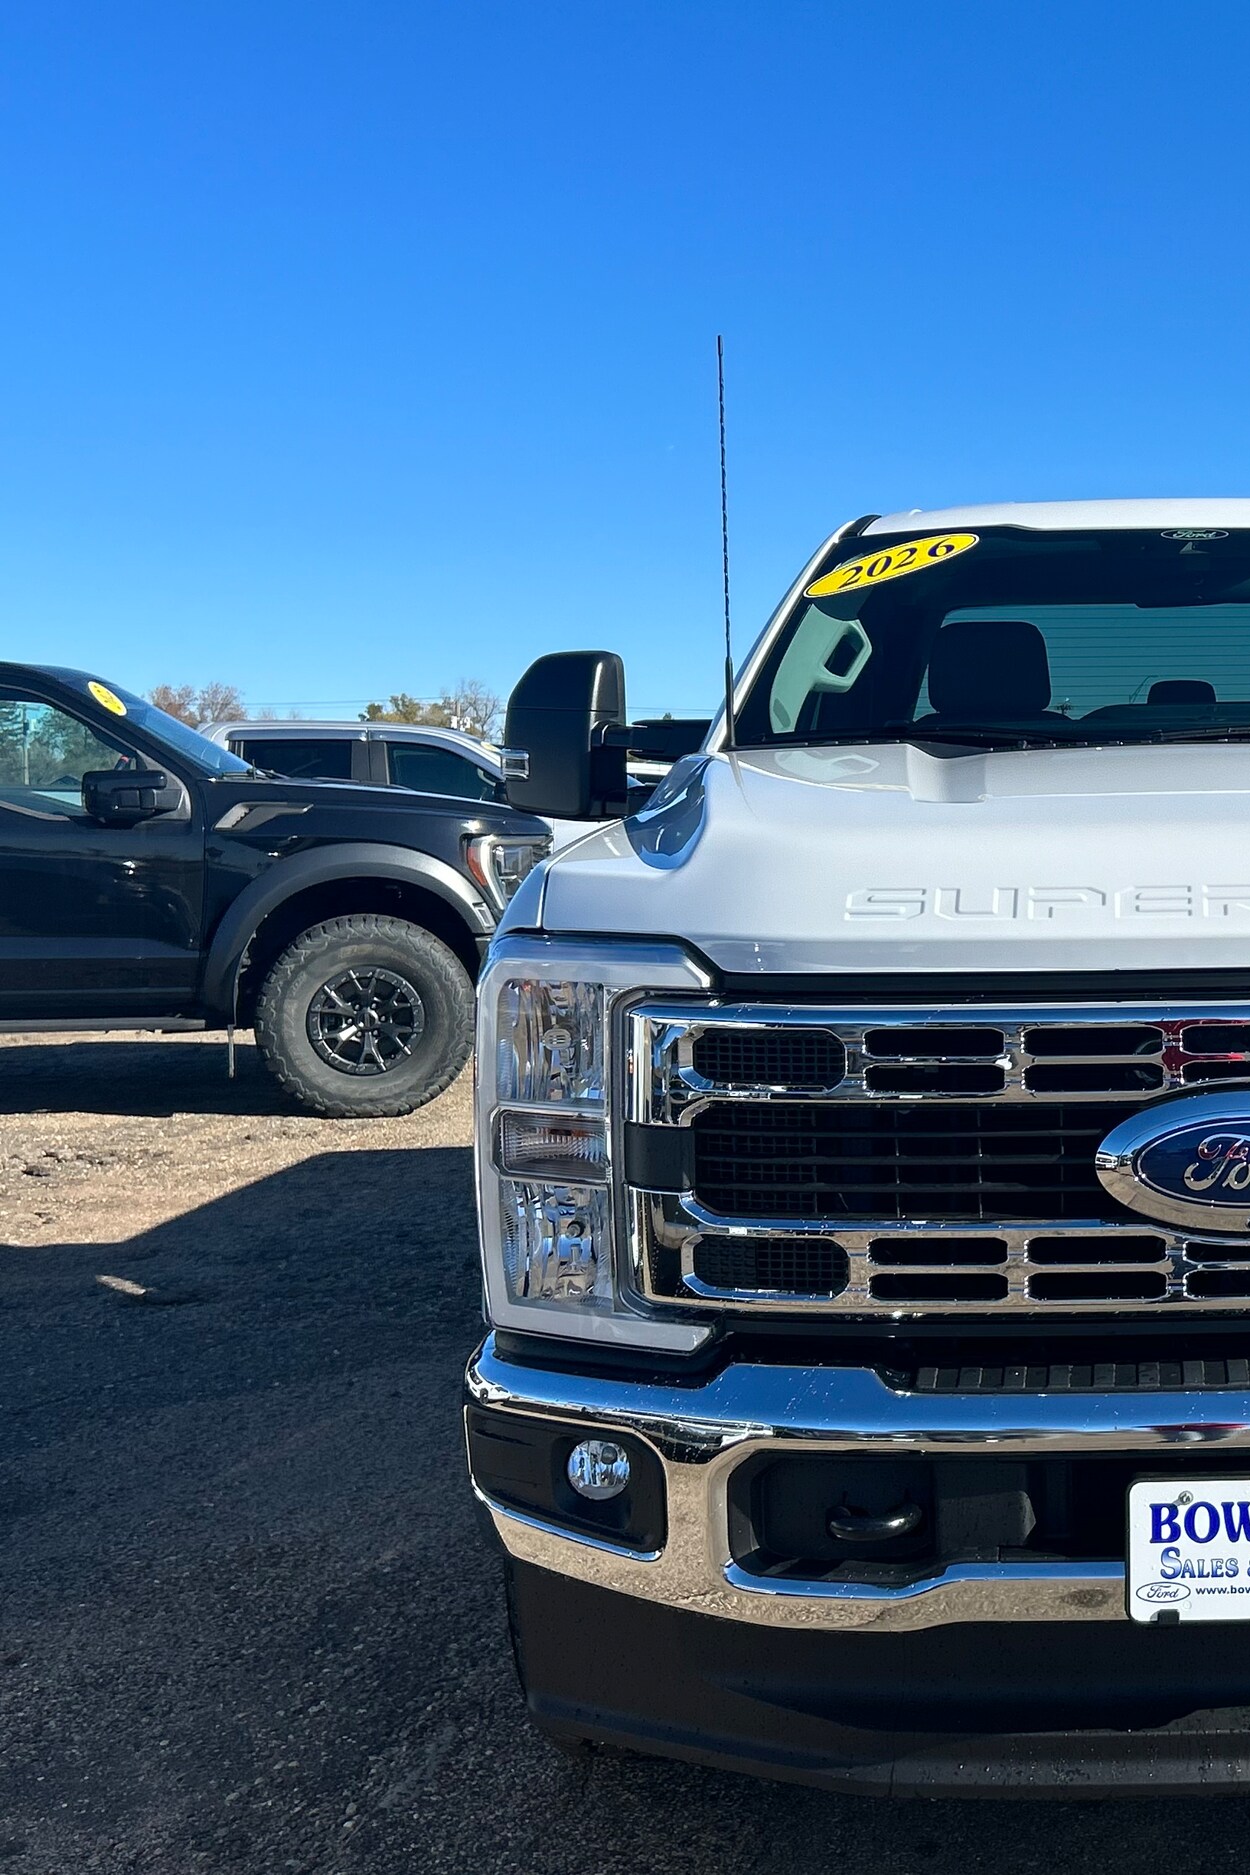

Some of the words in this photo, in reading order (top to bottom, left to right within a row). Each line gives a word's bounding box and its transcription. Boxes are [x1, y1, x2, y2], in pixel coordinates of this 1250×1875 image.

[1172, 529, 1217, 539] Ford
[837, 538, 956, 590] 2026
[1160, 1546, 1240, 1580] SALES
[1146, 1584, 1180, 1599] Ford
